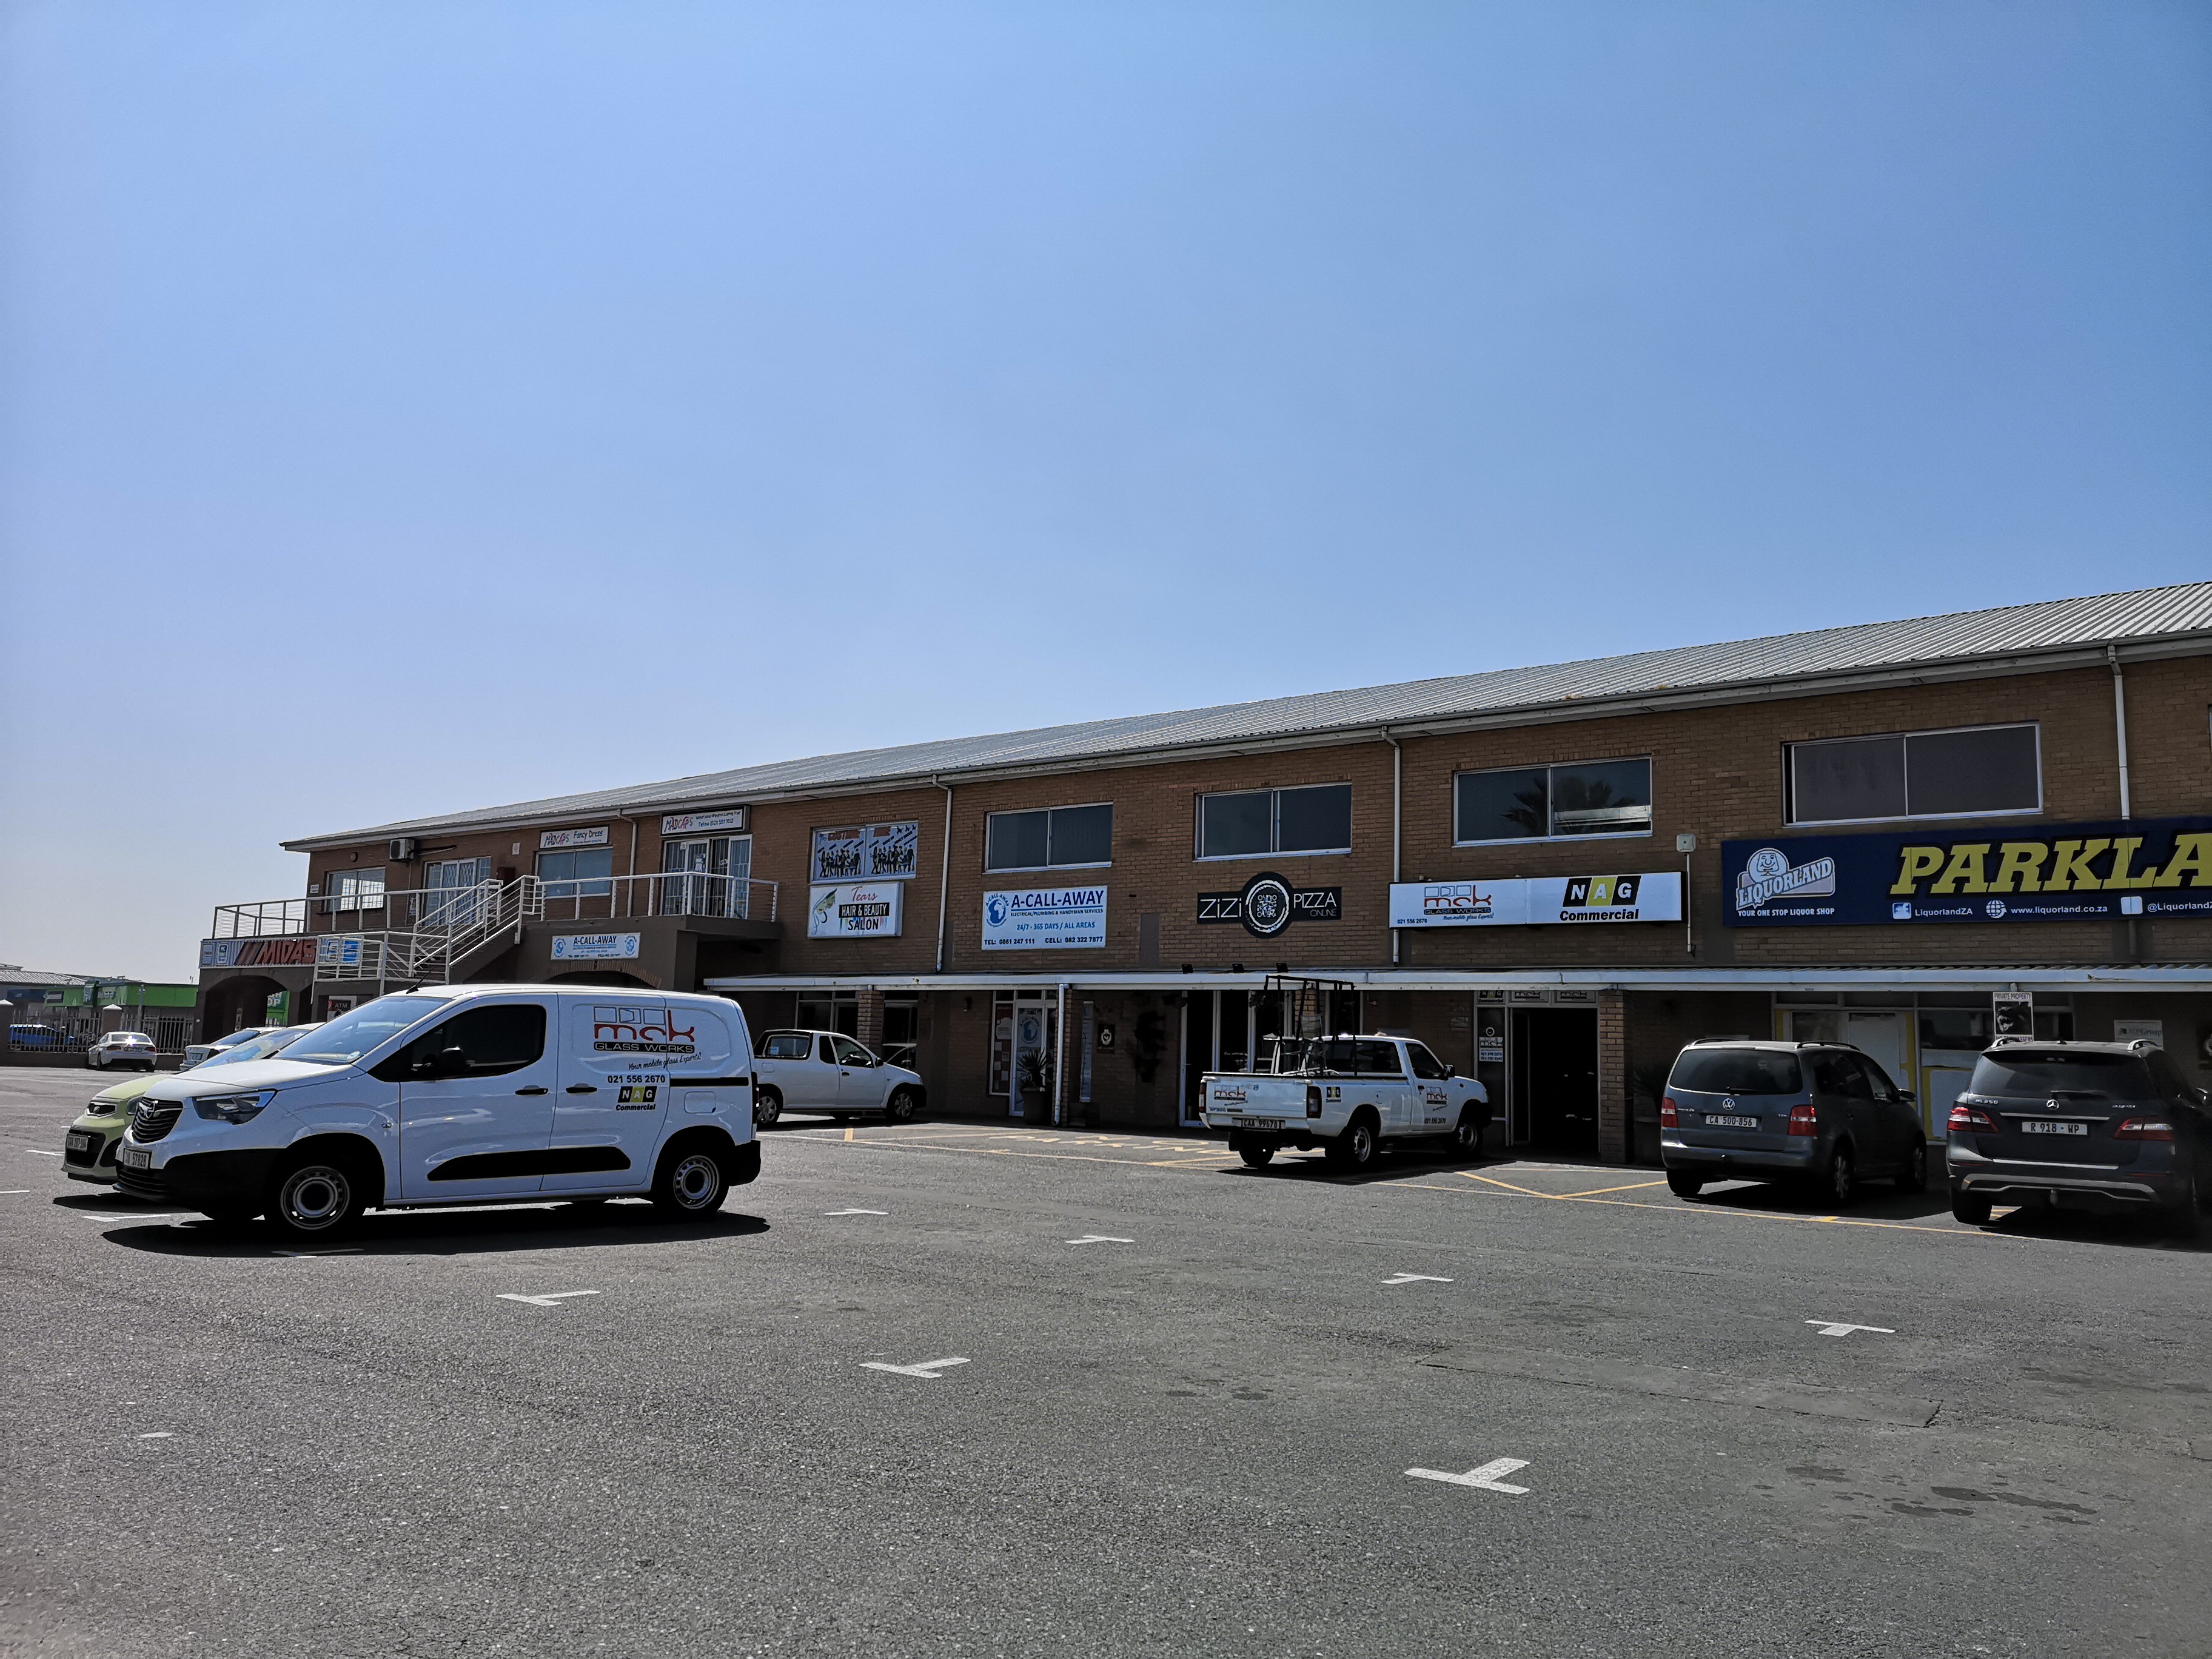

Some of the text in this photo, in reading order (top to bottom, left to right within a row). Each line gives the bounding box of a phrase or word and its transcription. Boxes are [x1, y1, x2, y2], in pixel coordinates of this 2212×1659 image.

[664, 816, 693, 833] MADCAPS
[543, 833, 569, 847] MADCAPS
[573, 831, 588, 840] Fancy
[1889, 833, 2212, 894] PARKLA
[1738, 859, 1832, 907] LIQUORLAND
[851, 885, 878, 902] Tears
[1424, 885, 1492, 908] mck
[1570, 882, 1632, 900] NAG
[1011, 890, 1104, 908] A-CALL-AWAY
[1293, 891, 1337, 908] PIZZA
[842, 903, 887, 917] HAIR & BEAUTY
[1310, 908, 1337, 917] ONLINE
[1560, 908, 1640, 921] Commercial
[1915, 908, 1973, 917] LiquorlandZA
[2011, 905, 2108, 915] www.liquorland.co.za
[848, 919, 879, 931] SALON
[1017, 923, 1029, 931] 24/7
[573, 936, 617, 945] A-CALL-AWAY
[255, 939, 317, 965] MIDAS
[594, 1010, 695, 1042] mck
[594, 1042, 693, 1053] GLASS WORKS
[643, 1058, 662, 1068] mobile
[663, 1056, 679, 1069] glass
[679, 1051, 702, 1064] Experts!
[608, 1075, 623, 1084] 021
[645, 1074, 666, 1083] 2670
[622, 1089, 653, 1099] NAG
[1214, 1085, 1246, 1098] mck
[1723, 1117, 1752, 1127] 500-856
[2040, 1124, 2057, 1133] 918
[2068, 1124, 2079, 1133] WP
